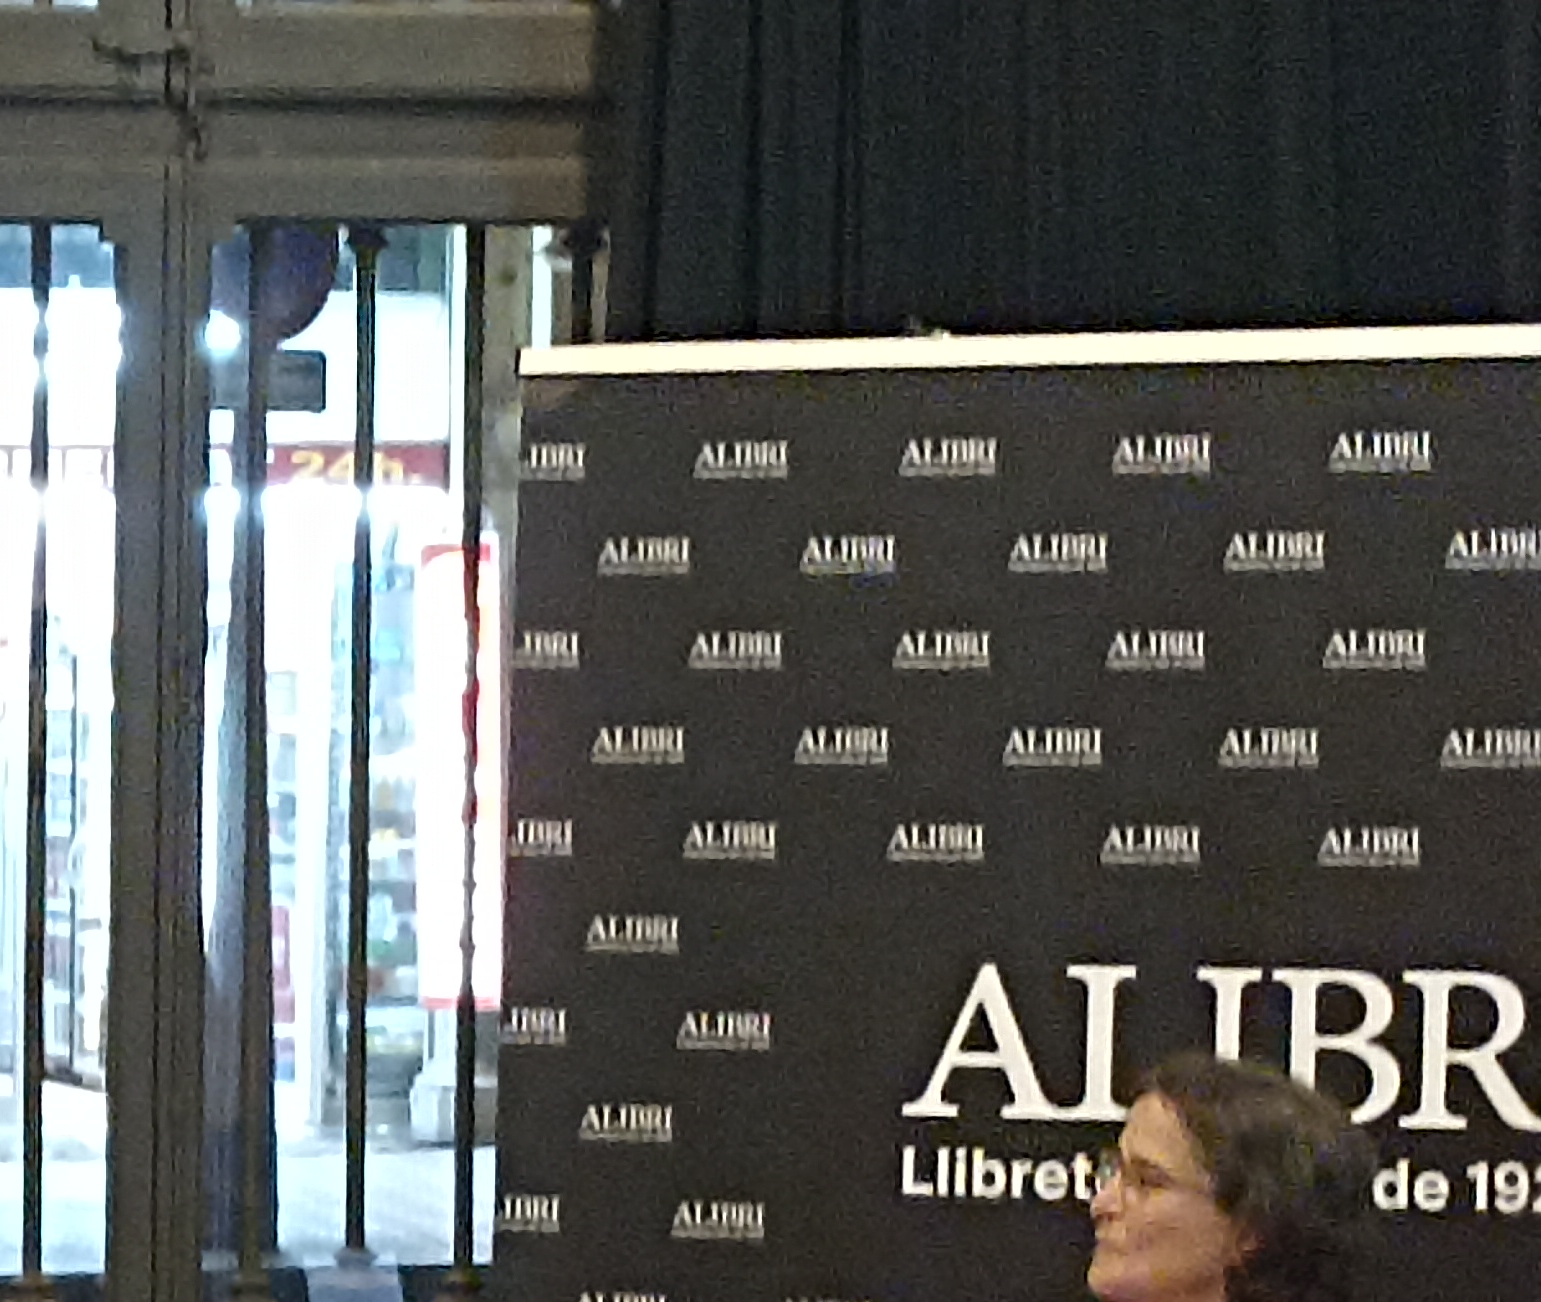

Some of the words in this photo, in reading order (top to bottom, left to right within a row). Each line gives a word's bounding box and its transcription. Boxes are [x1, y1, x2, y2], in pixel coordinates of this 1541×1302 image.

[694, 439, 787, 467] ALIBRI
[899, 437, 996, 465] ALIBRI
[1113, 432, 1210, 460] ALIBRI
[1330, 430, 1431, 458] ALIBRI
[599, 536, 689, 564] ALIBRI
[800, 534, 895, 562] ALIBRI
[1008, 533, 1107, 561] ALIBRI
[1224, 530, 1324, 558] ALIBRI
[690, 631, 781, 659] ALIBRI
[893, 630, 989, 658] ALIBRI
[1107, 630, 1205, 658] ALIBRI
[1323, 628, 1425, 656] ALIBRI
[592, 725, 684, 753] ALIBRI
[795, 726, 888, 754] ALIBRI
[1003, 727, 1101, 755] ALIBRI
[1219, 727, 1318, 755] ALIBRI
[684, 820, 776, 848] ALIBRI
[888, 822, 984, 850] ALIBRI
[1101, 825, 1200, 853] ALIBRI
[1318, 826, 1419, 854] ALIBRI
[587, 915, 678, 943] ALIBRI
[677, 1011, 770, 1039] ALIBRI
[581, 1103, 672, 1131] ALIBRI
[901, 1146, 1099, 1201] Llibret
[1372, 1158, 1450, 1213] de
[672, 1201, 764, 1229] ALIBRI
